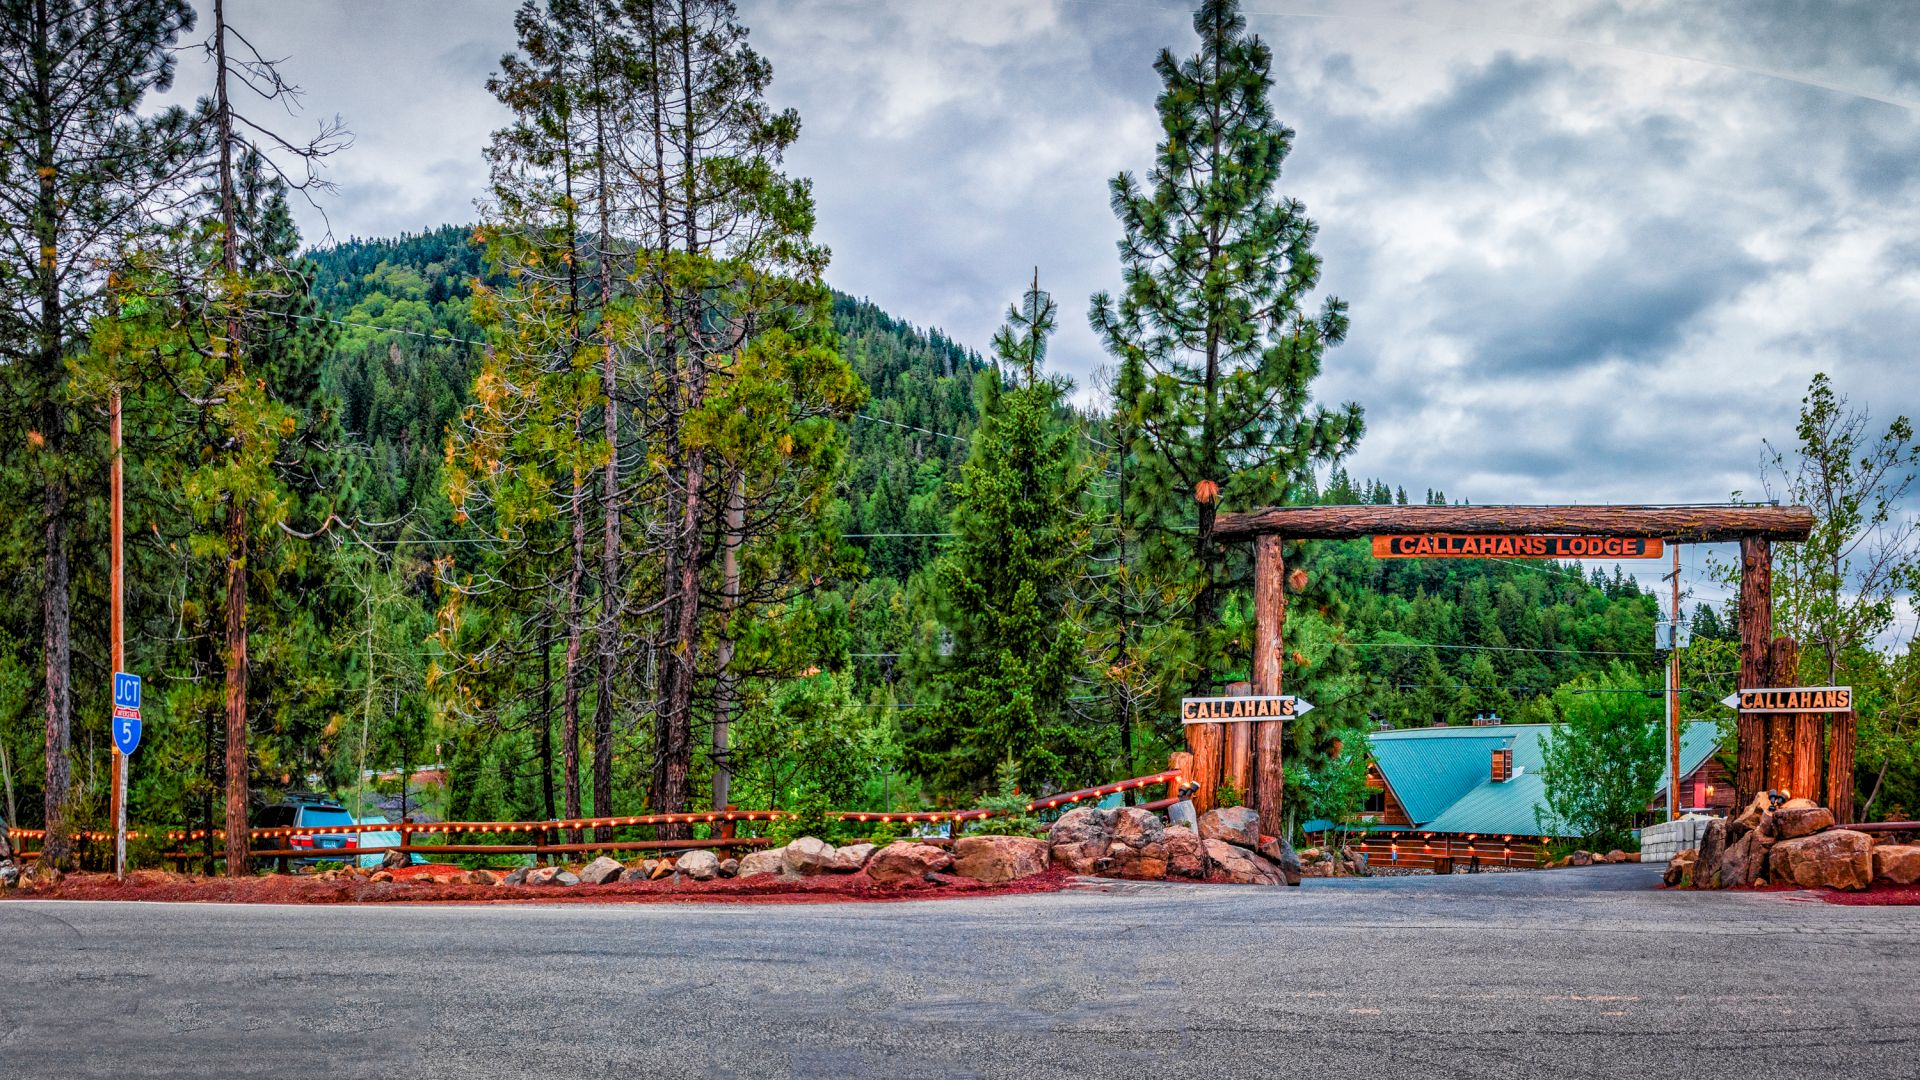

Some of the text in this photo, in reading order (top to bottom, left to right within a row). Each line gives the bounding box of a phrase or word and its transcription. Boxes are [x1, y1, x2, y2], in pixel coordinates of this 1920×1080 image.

[1400, 537, 1637, 555] CALLAHANS LODGE
[117, 679, 139, 702] JCT
[1741, 690, 1849, 709] CALLAHANS
[1184, 700, 1294, 719] CALLAHANS
[122, 722, 132, 744] 5
